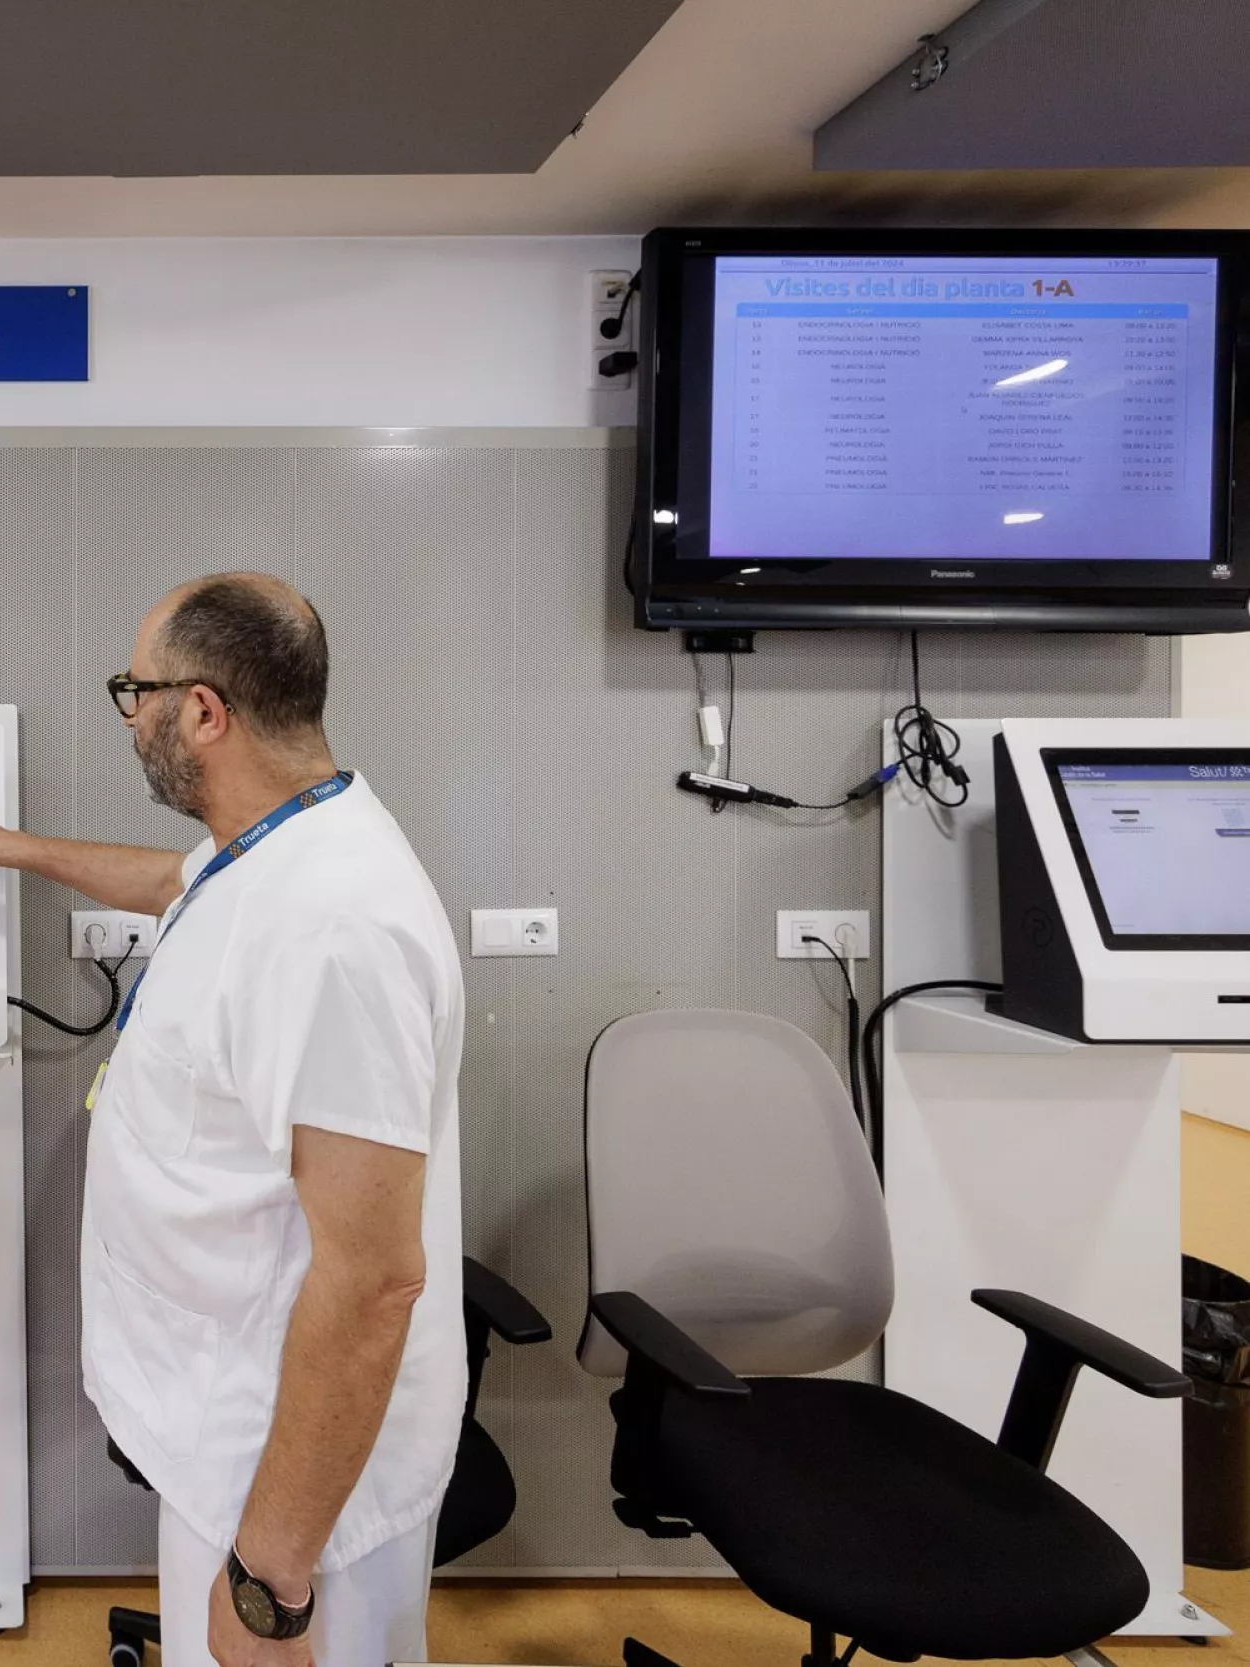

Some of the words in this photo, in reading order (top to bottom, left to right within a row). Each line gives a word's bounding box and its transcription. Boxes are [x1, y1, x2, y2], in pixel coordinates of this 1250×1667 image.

[766, 277, 850, 297] Visites
[855, 277, 896, 297] del
[901, 277, 939, 297] dia
[944, 278, 1025, 302] planta
[1031, 279, 1075, 297] 1-A
[931, 569, 975, 578] Panasonic
[1188, 765, 1227, 778] Salut/
[311, 782, 338, 798] Trueta
[238, 822, 269, 847] Trueta
